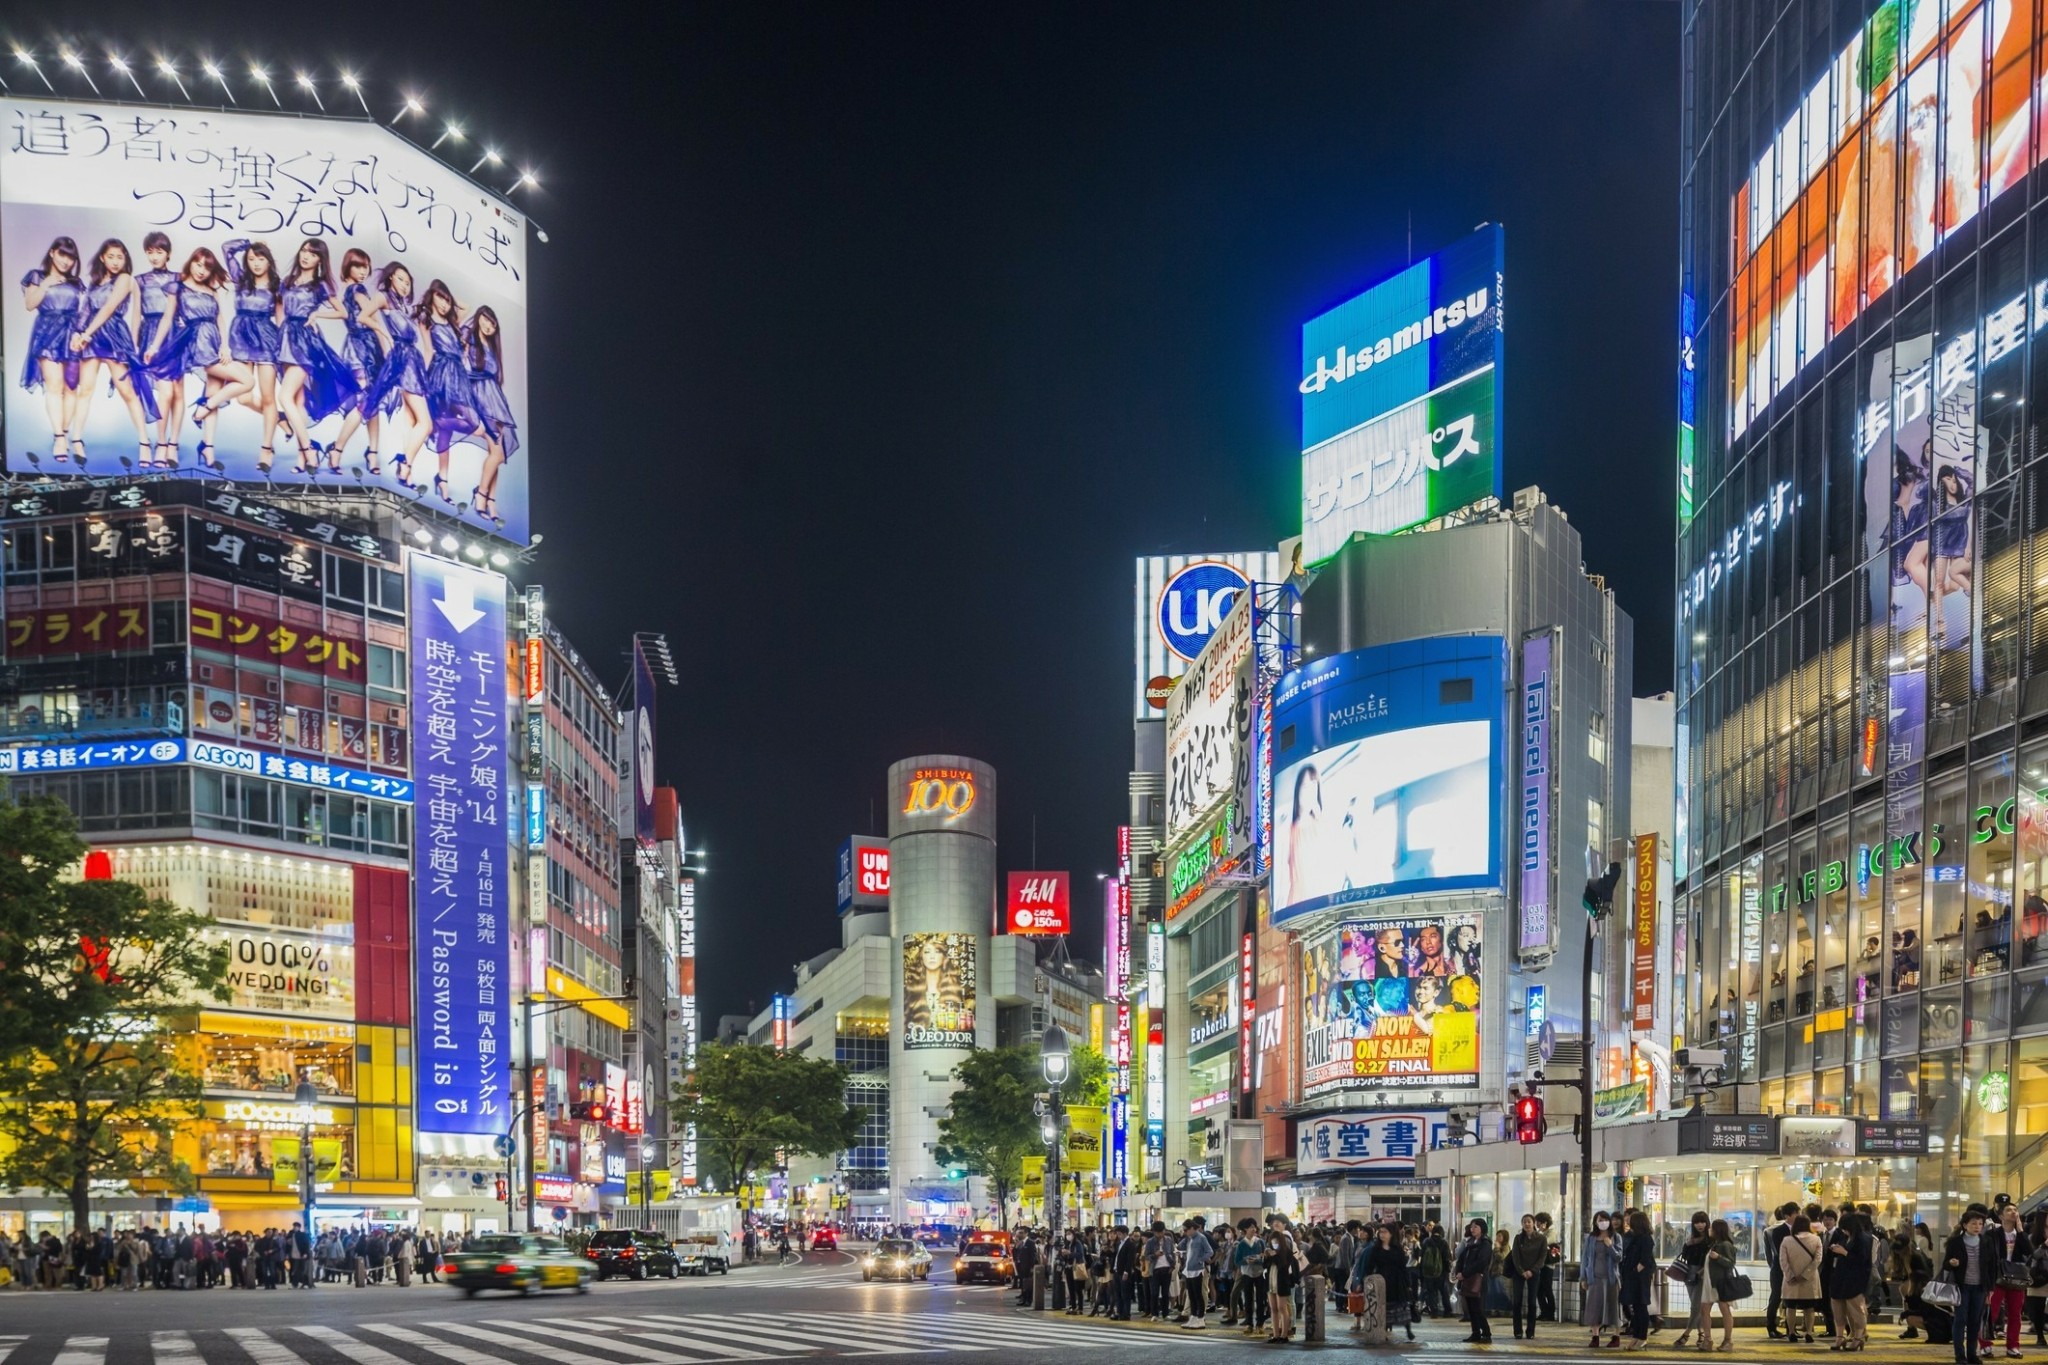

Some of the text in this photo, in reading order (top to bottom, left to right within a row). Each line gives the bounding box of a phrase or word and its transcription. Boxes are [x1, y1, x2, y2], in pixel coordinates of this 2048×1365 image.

[132, 187, 407, 253] つまらない。
[1299, 287, 1487, 394] Hisamitsu
[1302, 414, 1480, 523] サロンパス
[206, 522, 222, 534] 9F
[8, 608, 144, 648] プライス
[191, 607, 361, 671] コンタクト
[1276, 668, 1339, 707] MUSEE Channel
[426, 637, 457, 766] 時空を超え
[1329, 697, 1389, 723] MUSÉE
[1328, 709, 1389, 731] PLATINUM
[22, 745, 173, 769] 英会話イーオン 6F
[194, 744, 254, 769] AEON
[1235, 677, 1252, 843] もんじゃ
[265, 756, 409, 798] 英会話イーオン
[916, 770, 973, 781] SHIBUYA
[1524, 671, 1546, 871] Taisei neon
[903, 778, 976, 822] 109
[863, 853, 888, 871] UN
[533, 862, 542, 916] 渋谷駅前ビル
[1020, 878, 1078, 904] H&M
[1639, 839, 1653, 945] クスリのことなら
[477, 912, 496, 945] 発売
[1033, 917, 1062, 928] 150m
[1524, 923, 1546, 935] 2468
[226, 972, 329, 996] WEDDING!
[477, 960, 496, 1006] 56枚目
[1634, 953, 1653, 1021] 三千里
[944, 1031, 974, 1043] D'OR
[1191, 1014, 1228, 1043] Euphoria
[1375, 1016, 1414, 1037] NOW
[1306, 1025, 1331, 1068] EXILE
[1356, 1037, 1432, 1060] ON SALE!!
[434, 1062, 459, 1085] is
[1354, 1060, 1432, 1074] 9.27 FINAL
[1069, 1141, 1099, 1152] New Vitz
[1712, 1134, 1747, 1147] 渋谷駅
